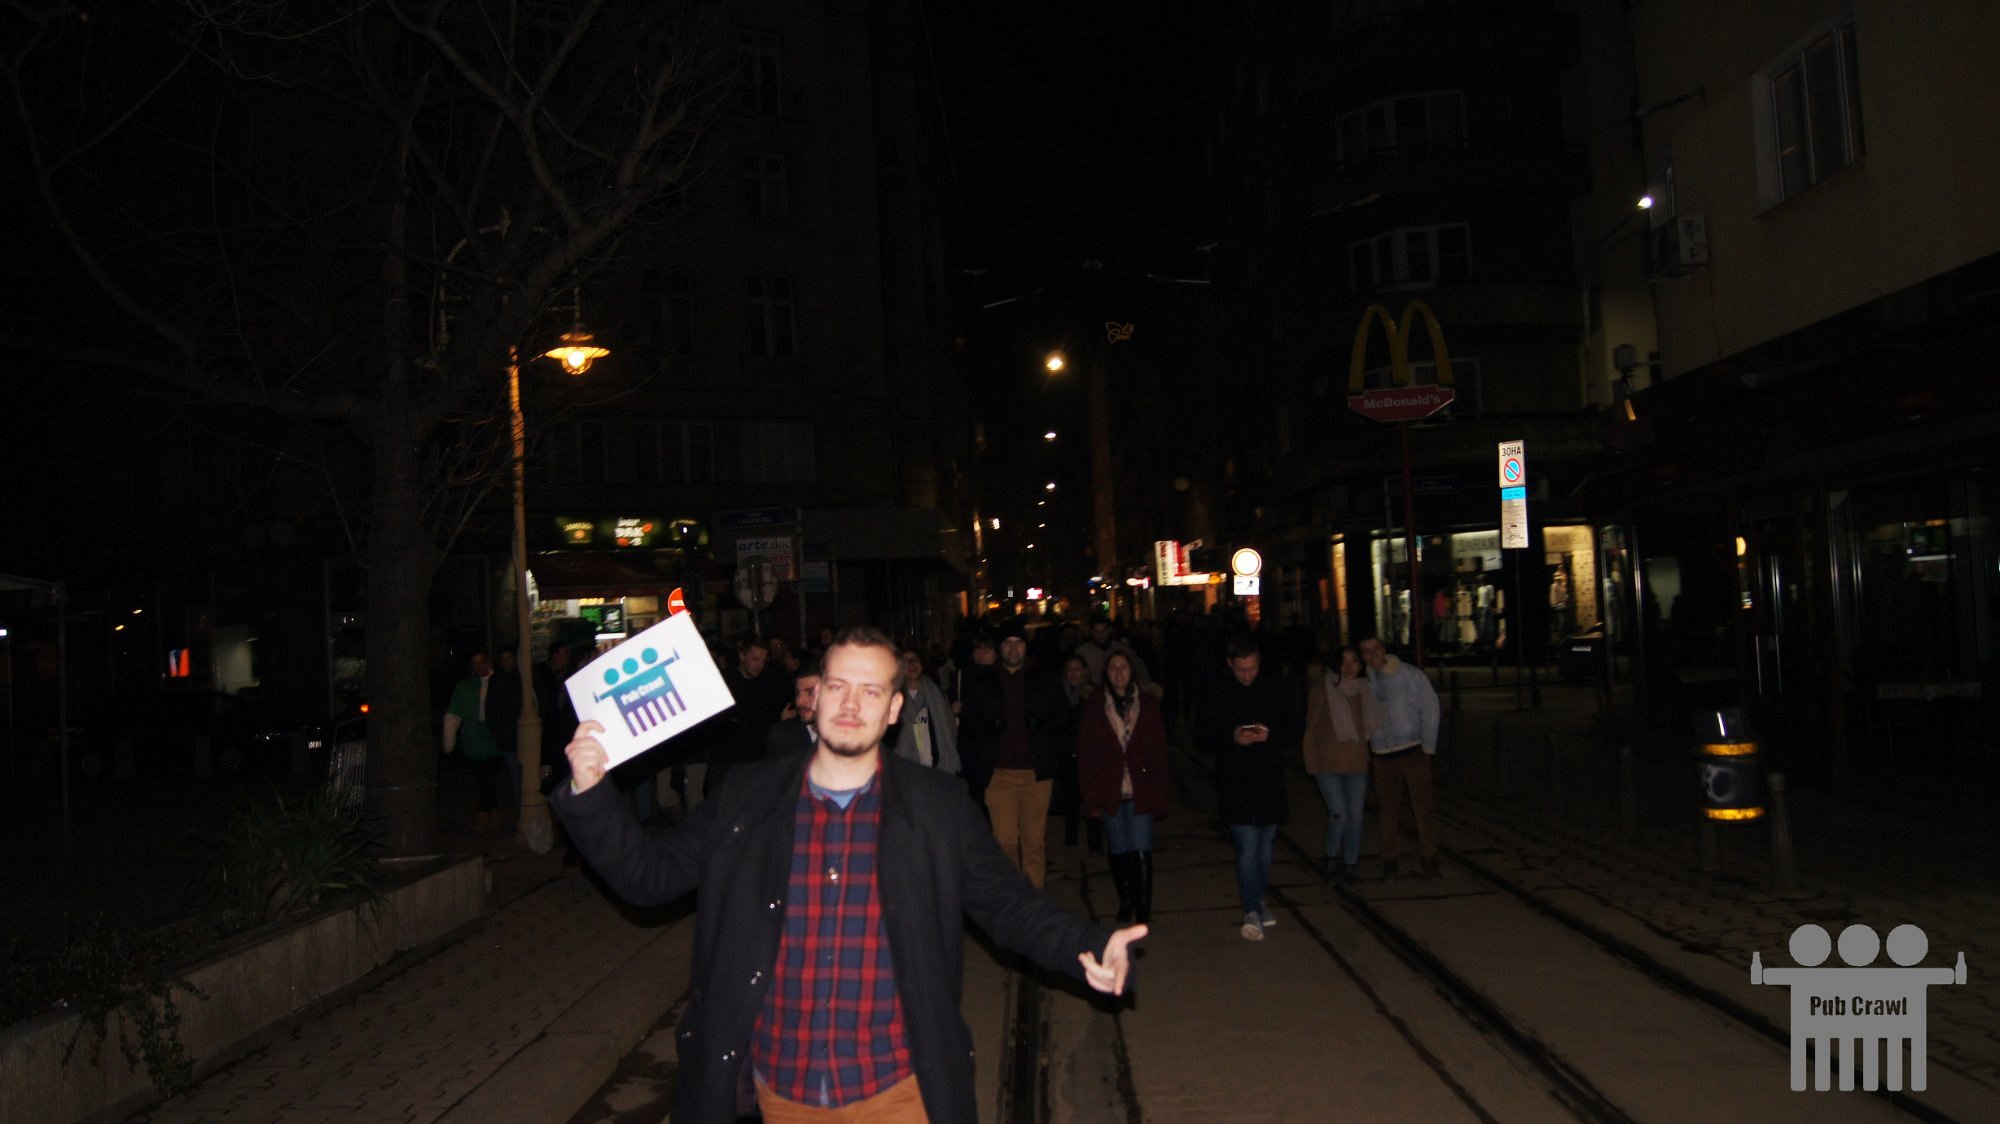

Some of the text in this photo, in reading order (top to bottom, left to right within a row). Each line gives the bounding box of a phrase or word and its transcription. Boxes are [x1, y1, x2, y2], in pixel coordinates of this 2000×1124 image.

[1364, 394, 1441, 408] McDonald's
[620, 676, 665, 705] Pub Crawl
